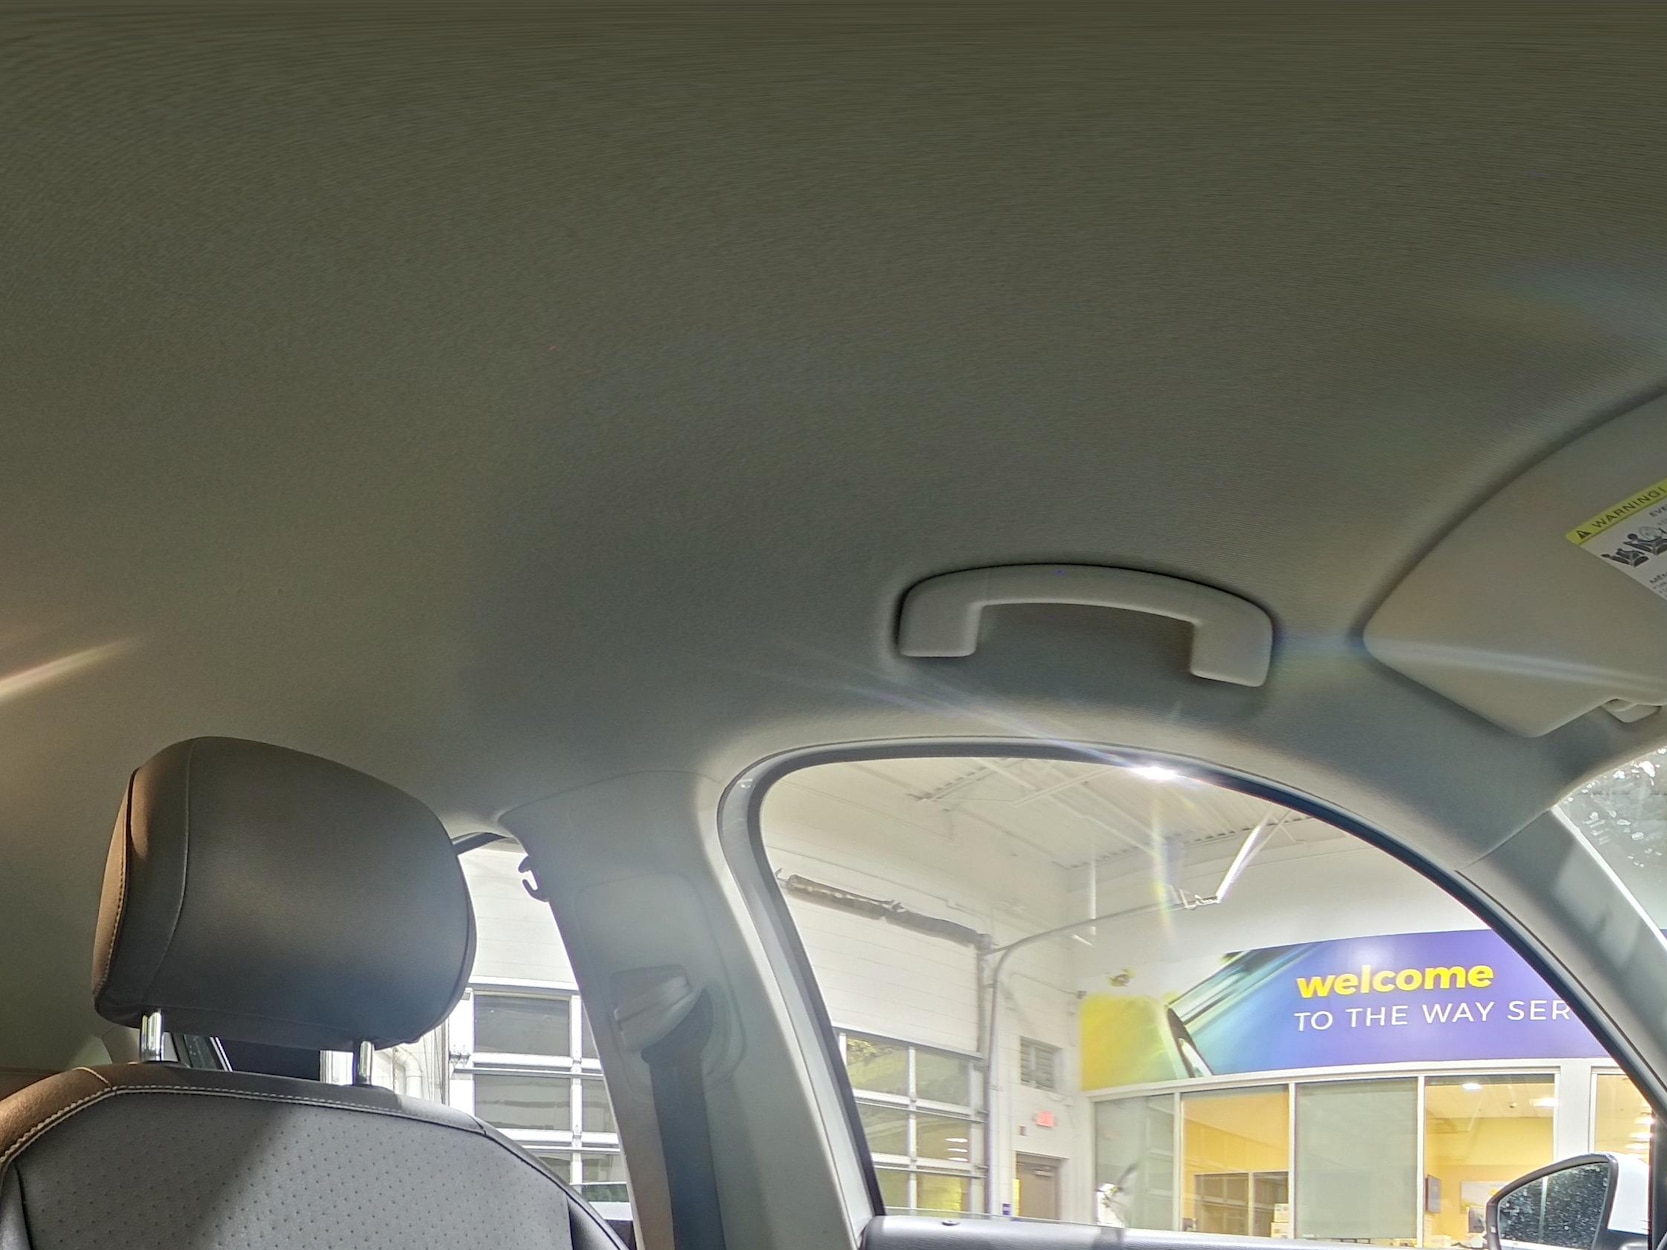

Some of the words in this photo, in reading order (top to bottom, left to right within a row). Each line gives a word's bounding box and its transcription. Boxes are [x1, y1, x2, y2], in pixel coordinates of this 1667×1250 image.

[1589, 486, 1667, 528] WARNING!
[1295, 964, 1494, 998] welcome
[1294, 1010, 1333, 1032] TO
[1345, 1005, 1408, 1028] THE
[1422, 1000, 1495, 1024] WAY
[1507, 999, 1573, 1022] SER
